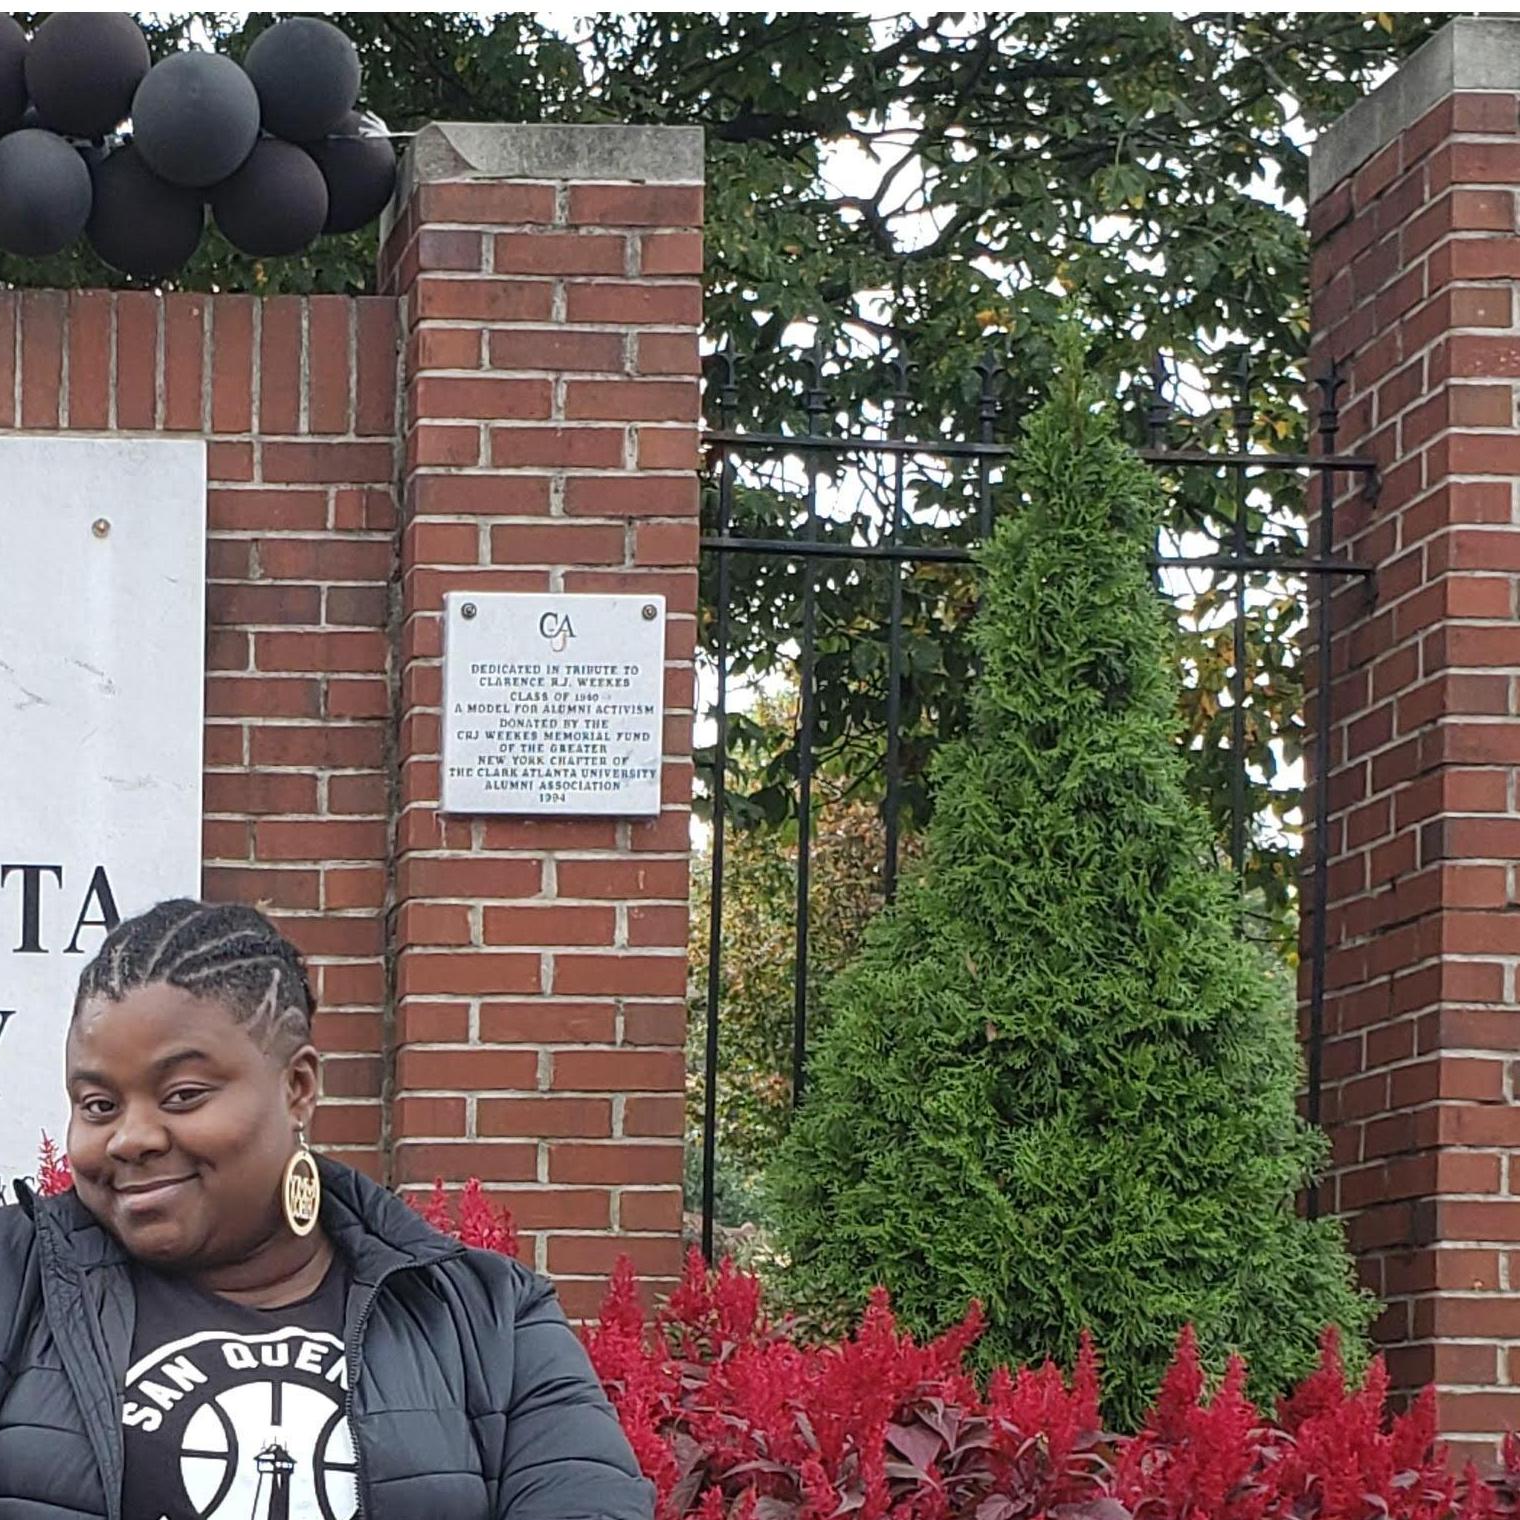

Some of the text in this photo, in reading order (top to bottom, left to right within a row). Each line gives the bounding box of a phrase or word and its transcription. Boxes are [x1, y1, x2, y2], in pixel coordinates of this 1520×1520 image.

[471, 664, 639, 675] DEDICATED IN TRIBUTE TO
[479, 677, 545, 687] CLARENCE
[577, 678, 631, 688] WEEKES
[510, 692, 548, 701] CLASS
[554, 692, 569, 701] OF
[454, 704, 654, 715] A MODEL FOR ALUMNI ACTIVISM
[499, 719, 609, 729] DONATED BY THE
[457, 730, 650, 741] CRJ WEEKES MEMORIAL FUND
[500, 744, 607, 753] OF THE GREATER
[478, 756, 629, 766] NEW YORK CHAPTER OF
[449, 767, 657, 778] THE CLARK ATLANTA UNIVERSITY
[485, 781, 620, 790] ALUMNI ASSOCIATION
[540, 794, 566, 803] 1994
[122, 1355, 208, 1432] SAN
